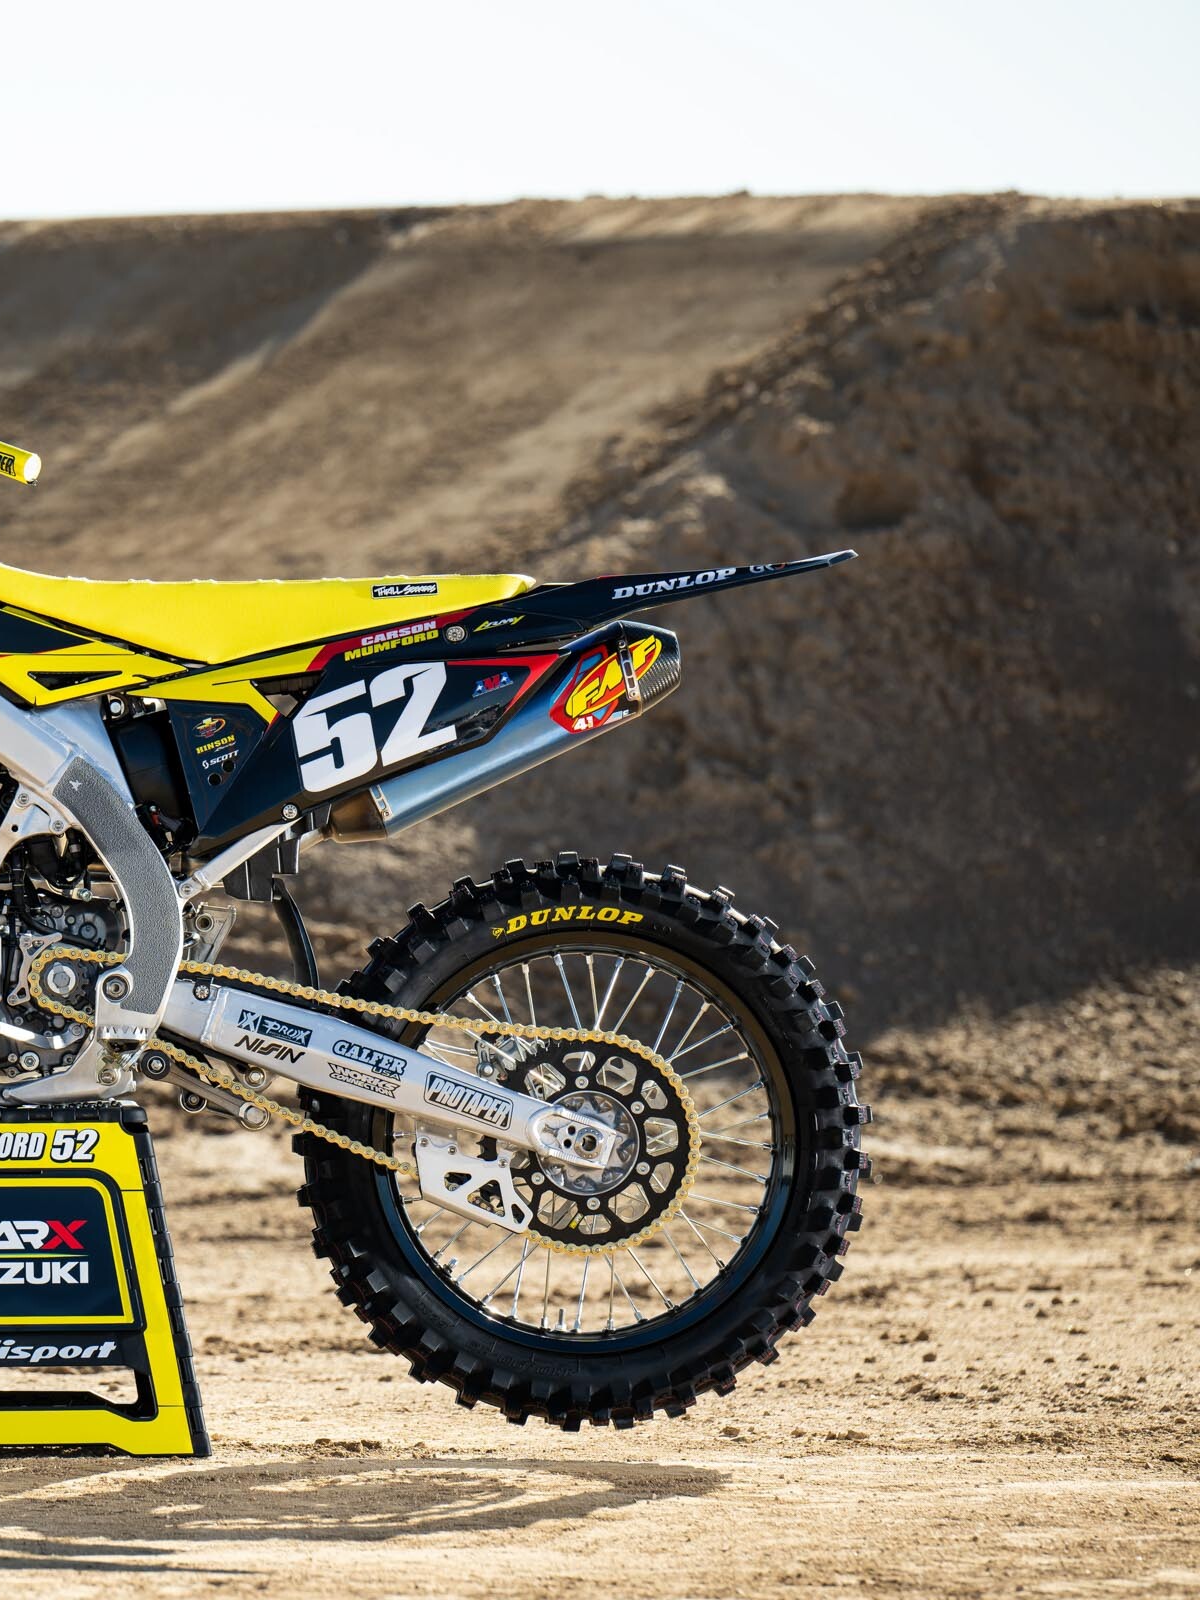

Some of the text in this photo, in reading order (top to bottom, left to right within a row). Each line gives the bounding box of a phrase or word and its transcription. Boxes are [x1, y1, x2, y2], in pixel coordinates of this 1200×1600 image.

[612, 567, 736, 600] DUNLOP
[344, 629, 439, 661] MUMFORD
[361, 620, 437, 646] CARSON
[472, 671, 513, 698] AMA
[293, 661, 457, 793] 52
[195, 735, 235, 754] HINSON
[210, 750, 239, 765] SCOTT
[506, 906, 644, 934] DUNLOP
[332, 1040, 407, 1075] GALFER
[330, 1064, 400, 1091] WORKS
[331, 1073, 398, 1098] CONNECTION
[372, 1066, 400, 1080] USA
[429, 1077, 513, 1128] PROTAPER
[50, 1128, 99, 1163] 52
